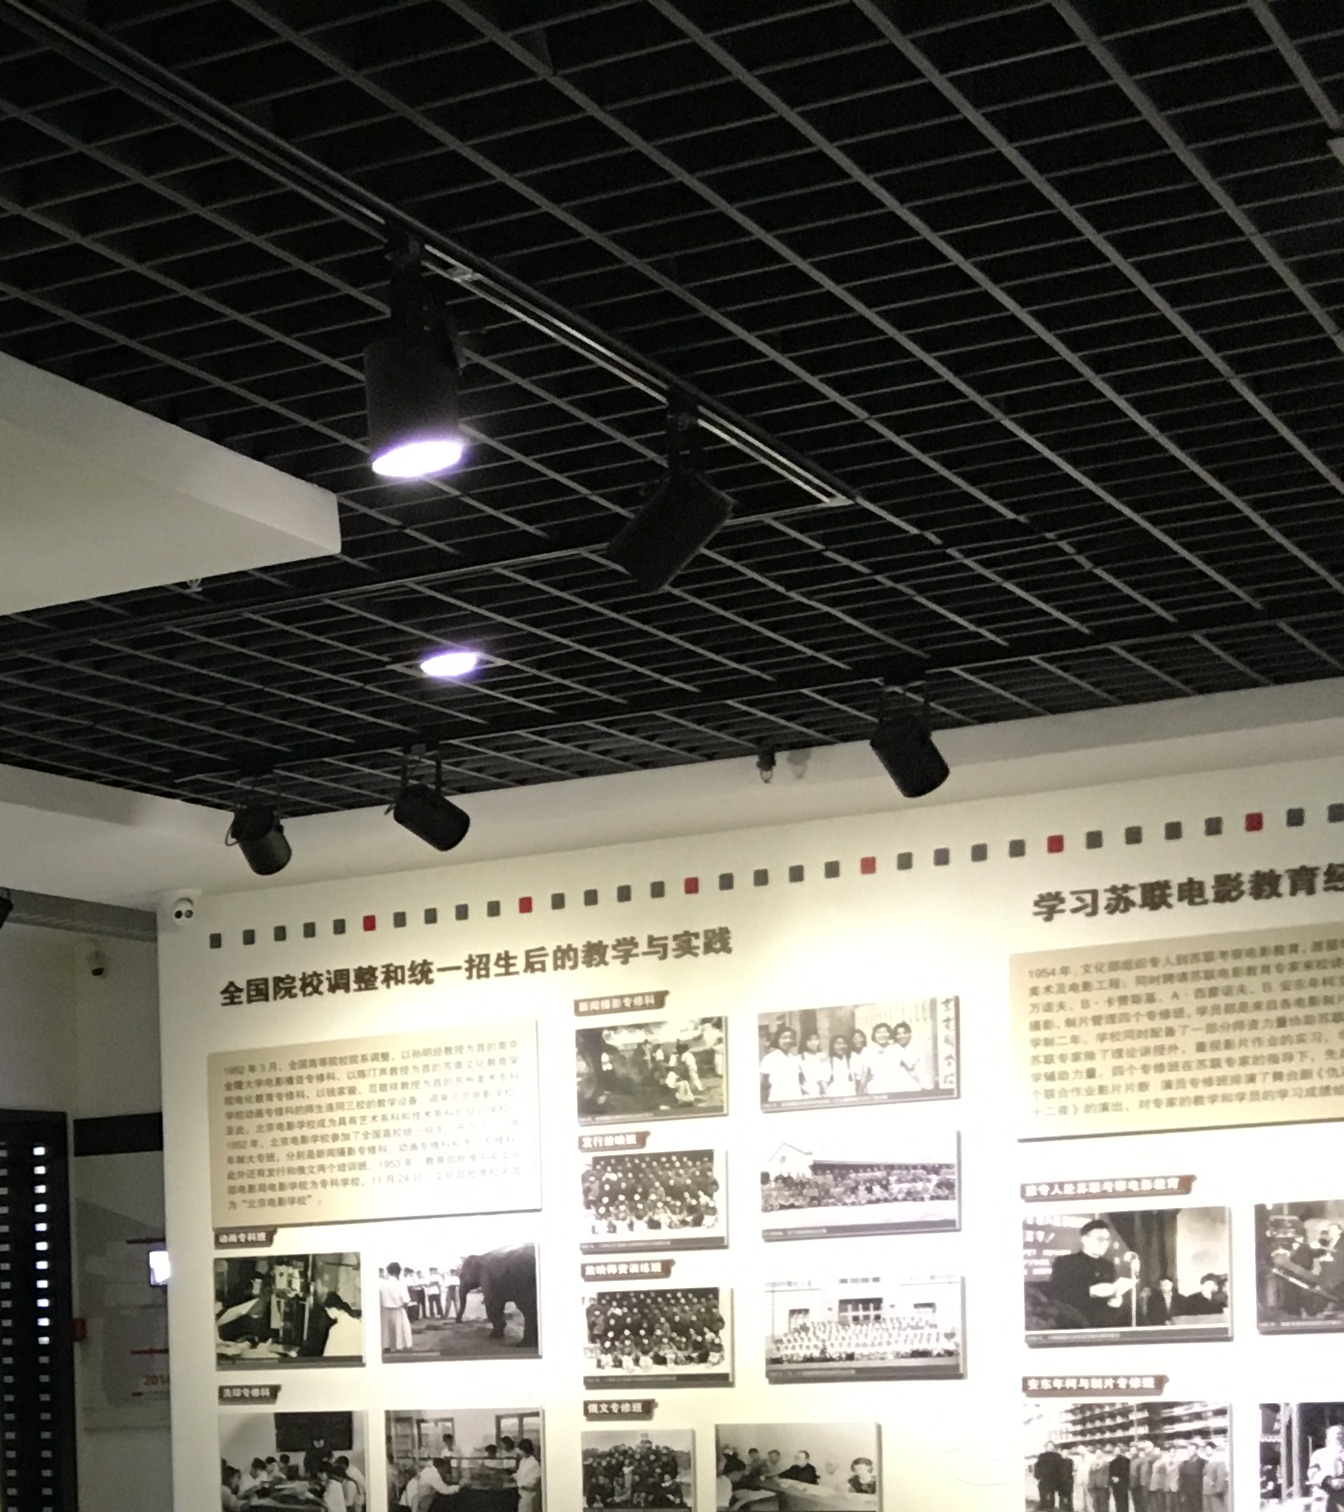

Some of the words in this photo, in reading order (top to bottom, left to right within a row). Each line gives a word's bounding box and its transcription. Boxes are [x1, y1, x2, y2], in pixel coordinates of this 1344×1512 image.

[220, 926, 734, 1007] 全国院校调整和统一招生后的教学与实践
